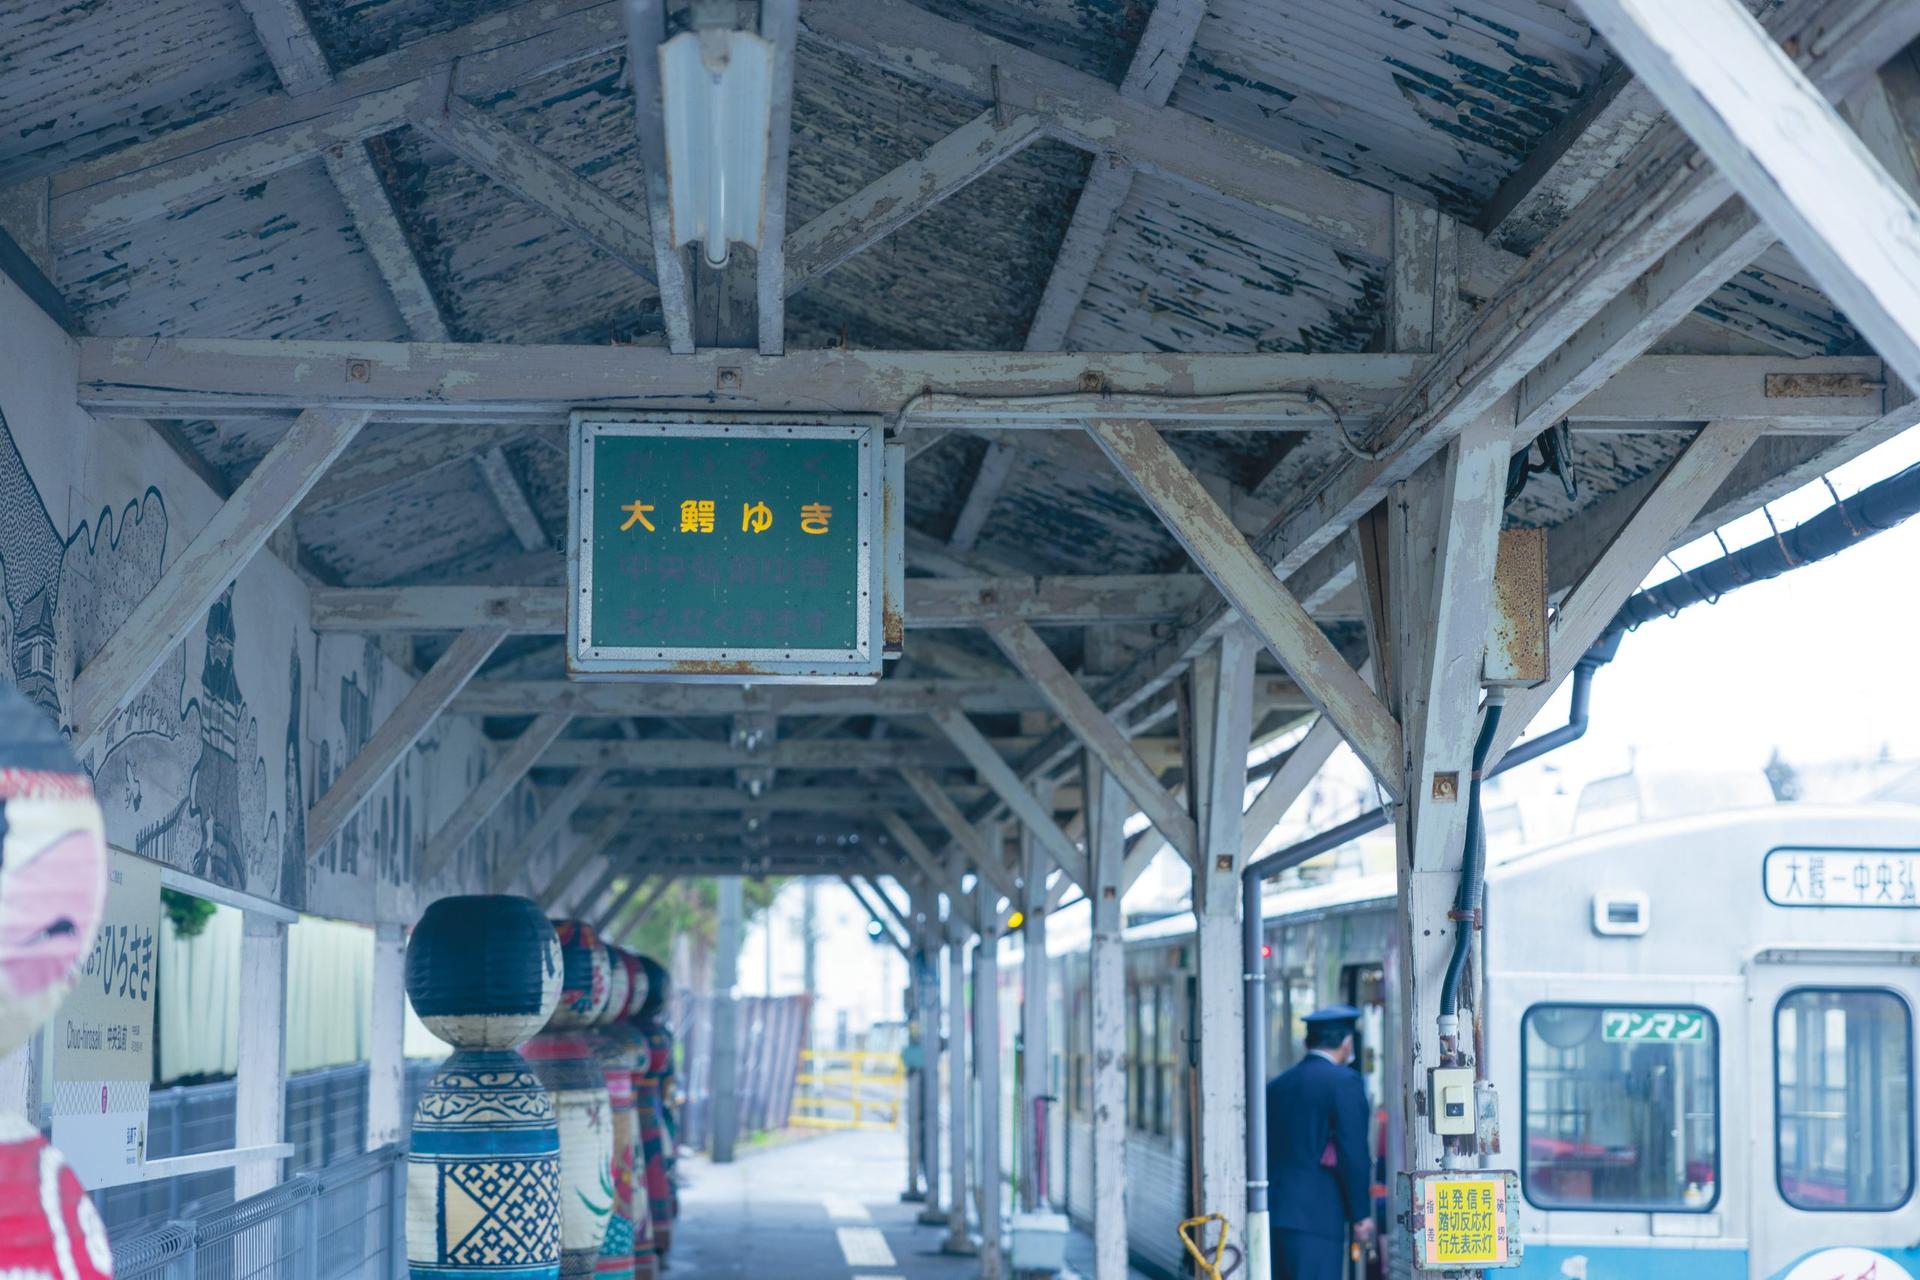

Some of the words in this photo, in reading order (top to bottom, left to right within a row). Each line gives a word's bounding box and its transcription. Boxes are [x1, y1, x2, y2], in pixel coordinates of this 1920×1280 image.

[619, 499, 833, 534] 大鰐ゆき
[1605, 1012, 1702, 1039] ワンマン
[1438, 1189, 1492, 1210] 出発信号
[1438, 1211, 1492, 1232] 踏切反応灯
[1438, 1233, 1493, 1254] 行先表示灯
